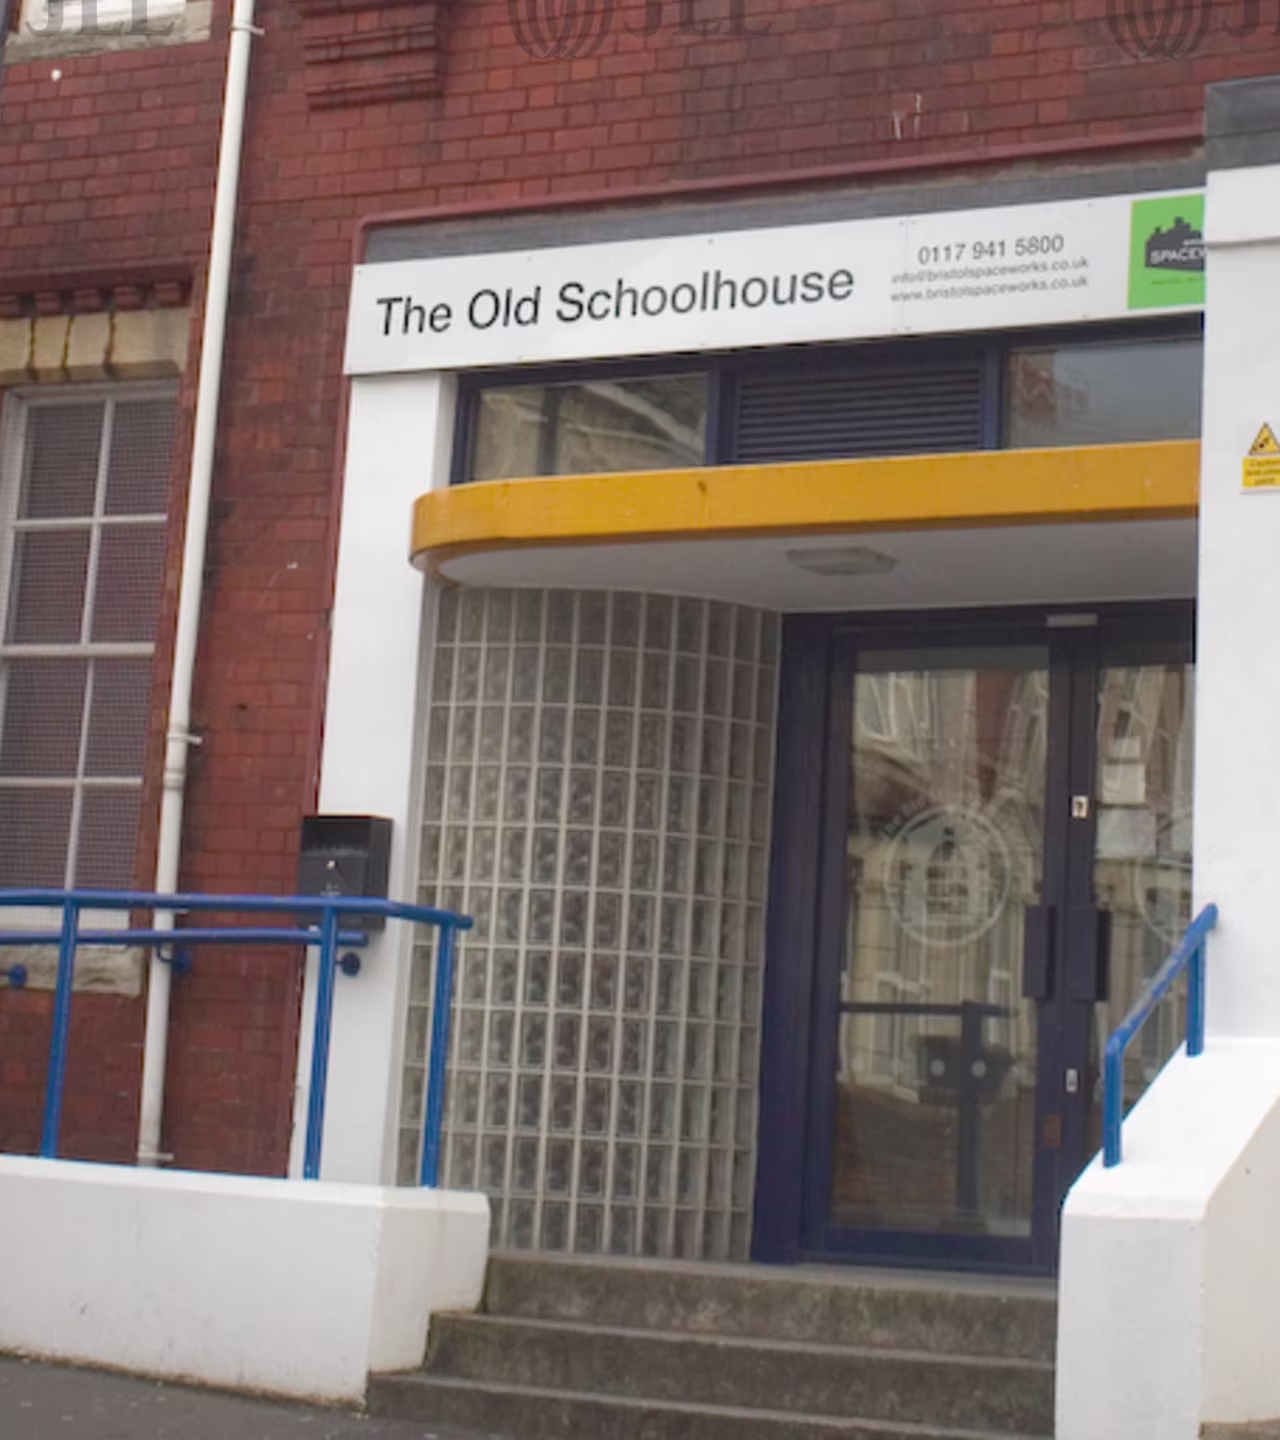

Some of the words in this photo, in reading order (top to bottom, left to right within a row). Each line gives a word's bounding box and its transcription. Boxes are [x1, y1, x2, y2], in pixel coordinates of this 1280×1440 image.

[917, 242, 966, 265] 0117
[972, 239, 1006, 261] 941
[1014, 234, 1065, 257] 5800
[376, 296, 454, 336] The
[467, 285, 541, 330] Old
[555, 268, 855, 323] Schoolhouse
[890, 275, 1088, 303] www.bristolspaceworks.co.uk
